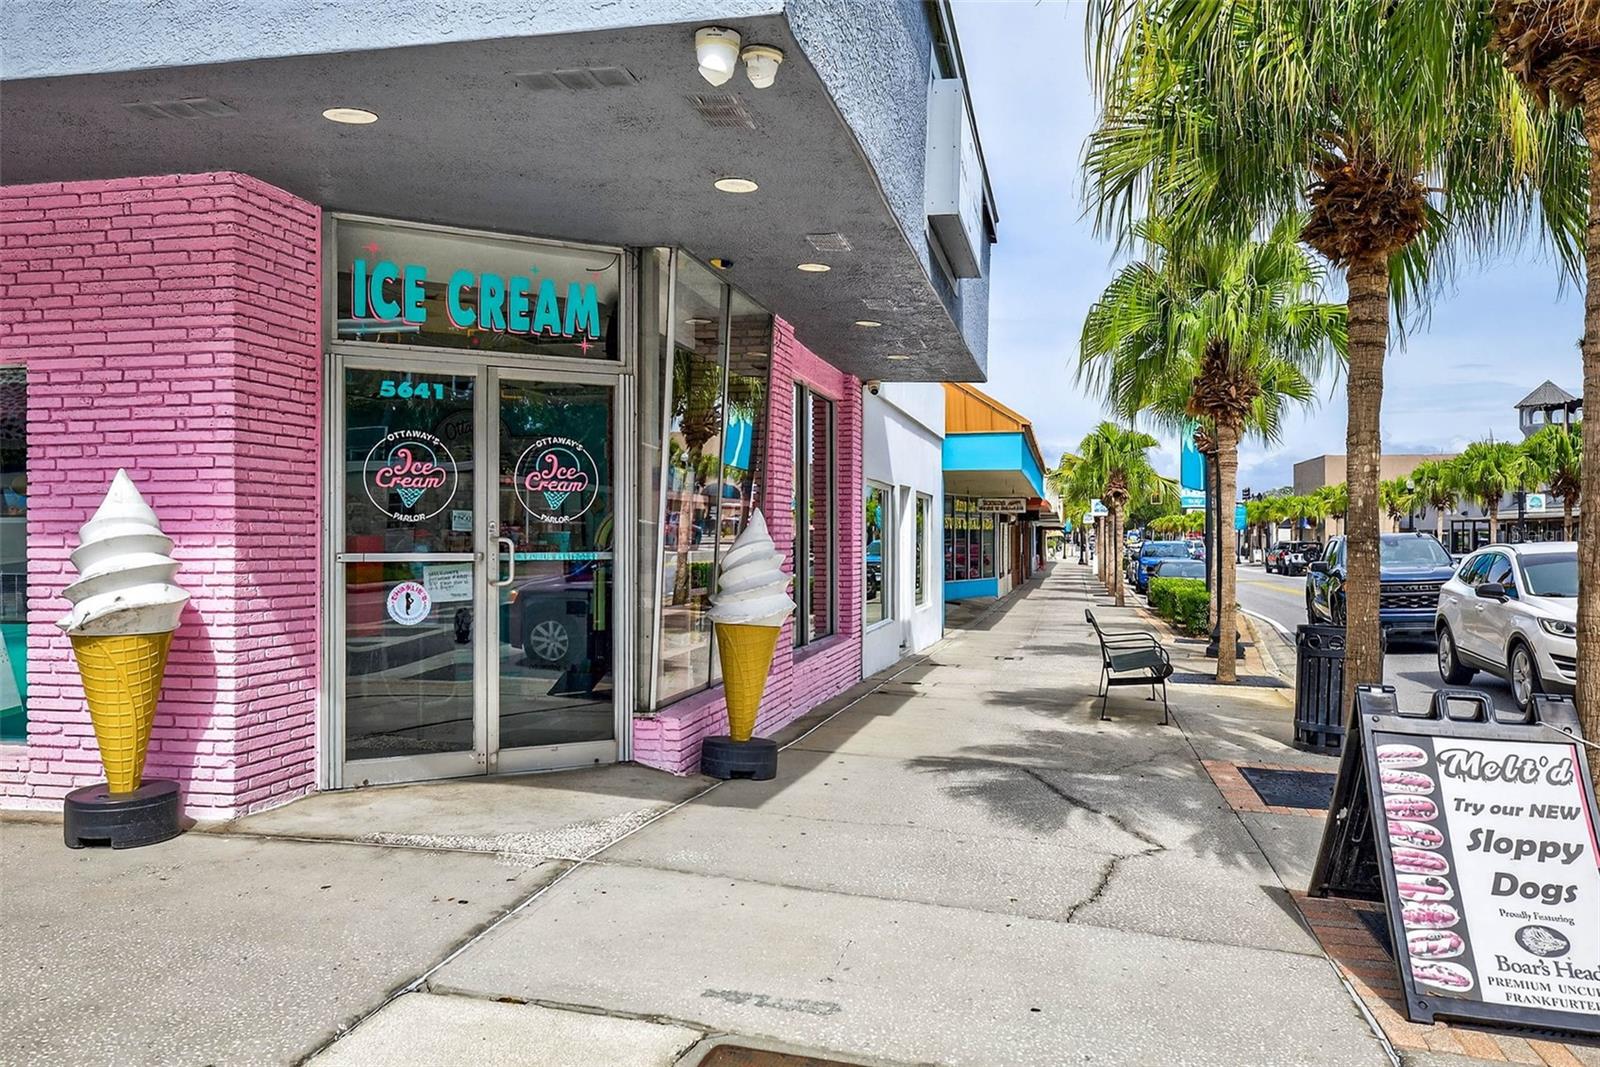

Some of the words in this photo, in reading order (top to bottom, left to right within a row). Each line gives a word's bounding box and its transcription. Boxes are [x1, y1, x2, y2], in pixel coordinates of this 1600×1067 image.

[352, 258, 428, 326] ICE
[445, 268, 600, 340] CREAM
[379, 380, 444, 400] 5641
[387, 430, 440, 445] OTTAWAY'S
[535, 437, 583, 451] OTTAWAY'S
[394, 448, 433, 475] Ice
[542, 454, 577, 479] Ice
[375, 467, 446, 488] Cream
[525, 472, 588, 492] Cream
[393, 512, 426, 522] PARLOR
[540, 514, 570, 523] PARLOR
[1435, 748, 1574, 786] Melt'd
[1454, 797, 1485, 816] Try
[1489, 803, 1524, 817] our
[1528, 803, 1581, 821] NEW
[1466, 827, 1584, 865] Sloppy
[1490, 871, 1578, 905] Dogs
[1498, 908, 1531, 922] Proudly
[1532, 911, 1576, 927] Featuring
[1494, 954, 1551, 976] Boar's
[1487, 976, 1552, 992] PREMIUM
